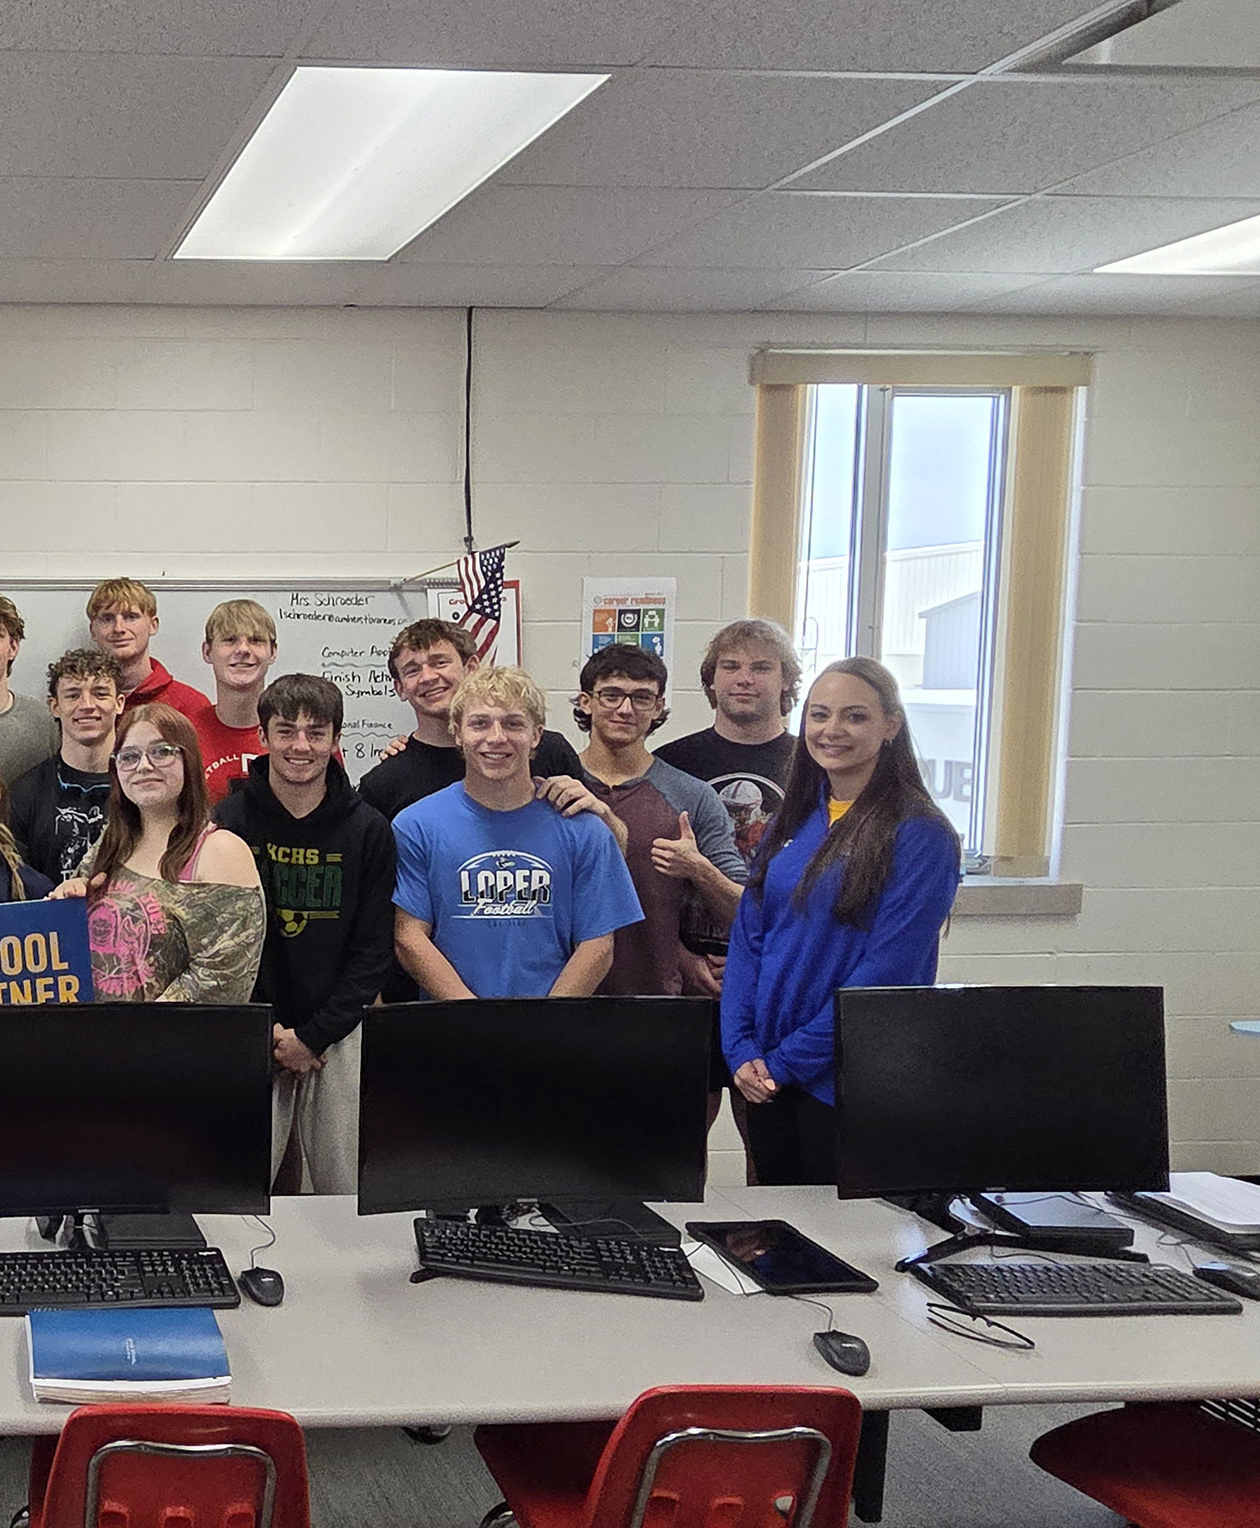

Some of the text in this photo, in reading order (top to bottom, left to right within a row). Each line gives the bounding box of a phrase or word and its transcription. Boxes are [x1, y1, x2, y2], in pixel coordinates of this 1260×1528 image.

[314, 593, 375, 607] Schroeder
[321, 646, 365, 659] Computer
[322, 670, 361, 683] Finish
[345, 684, 397, 698] Symbols
[361, 718, 393, 730] Finance
[354, 742, 365, 759] 8
[460, 869, 551, 903] LOPER
[470, 899, 538, 916] Football
